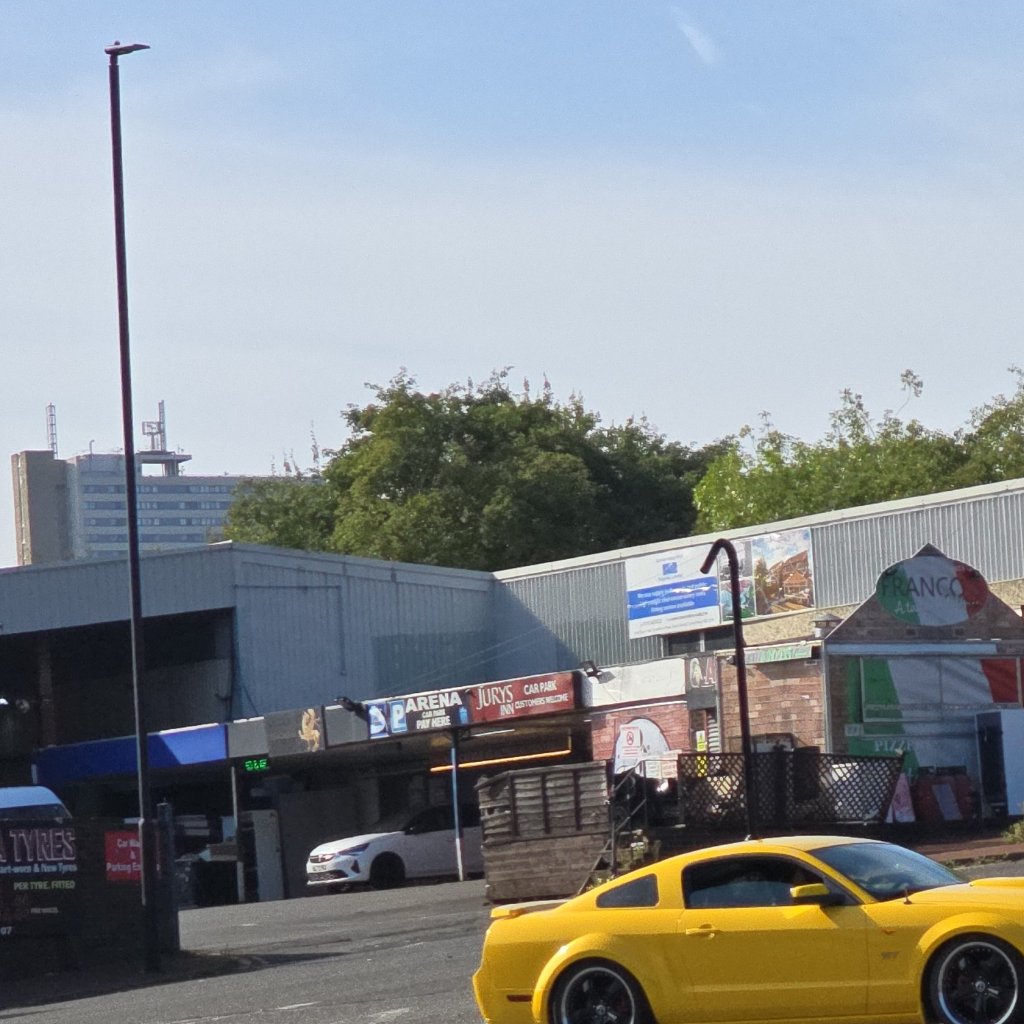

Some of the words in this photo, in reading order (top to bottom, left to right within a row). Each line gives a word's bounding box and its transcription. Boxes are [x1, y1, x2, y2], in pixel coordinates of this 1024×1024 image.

[523, 683, 539, 695] CAR
[539, 679, 557, 692] PARK
[405, 691, 463, 714] ARENA
[476, 684, 515, 710] JURYS
[500, 702, 515, 716] INN
[515, 697, 546, 709] CUSTOMERS
[545, 692, 569, 704] WELCOME
[416, 718, 431, 730] PAY
[431, 715, 452, 728] HERE
[9, 828, 76, 862] TYRES
[117, 838, 129, 849] Car
[33, 863, 40, 873] &
[40, 863, 57, 873] New
[57, 862, 78, 875] Tyres
[106, 862, 131, 874] Parking
[13, 881, 29, 891] PER
[51, 879, 76, 890] FITTED
